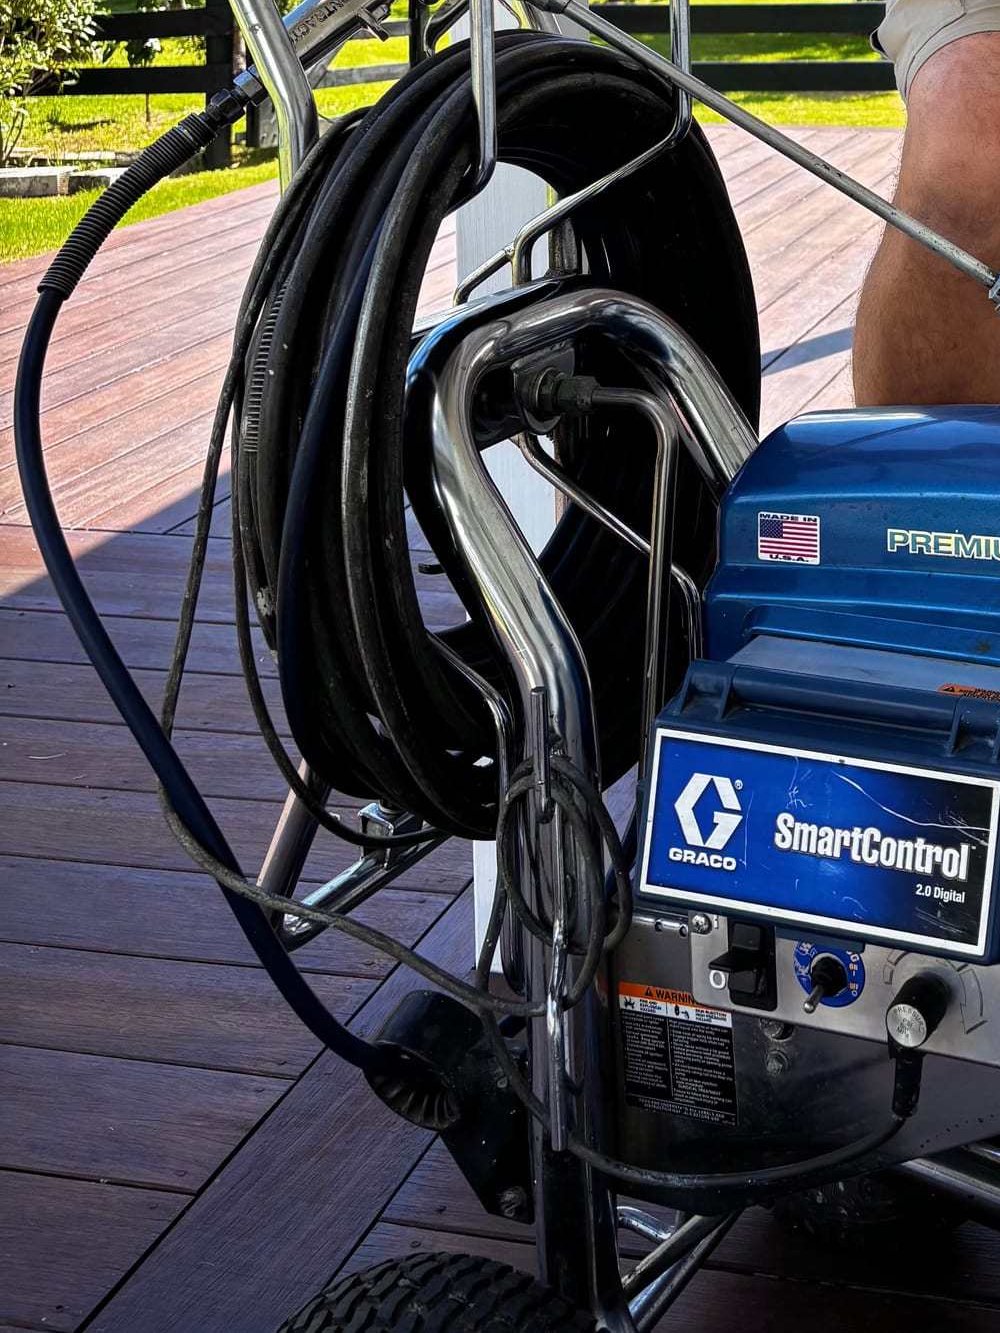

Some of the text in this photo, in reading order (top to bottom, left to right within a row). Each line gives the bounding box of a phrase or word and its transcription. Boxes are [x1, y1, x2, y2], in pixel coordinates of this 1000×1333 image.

[760, 513, 799, 521] MADE
[769, 554, 809, 562] U.S.A.
[773, 812, 969, 882] SmartControl
[668, 848, 737, 871] GRACO
[915, 883, 966, 904] 2.0 Digital
[655, 988, 698, 1004] WARNIN
